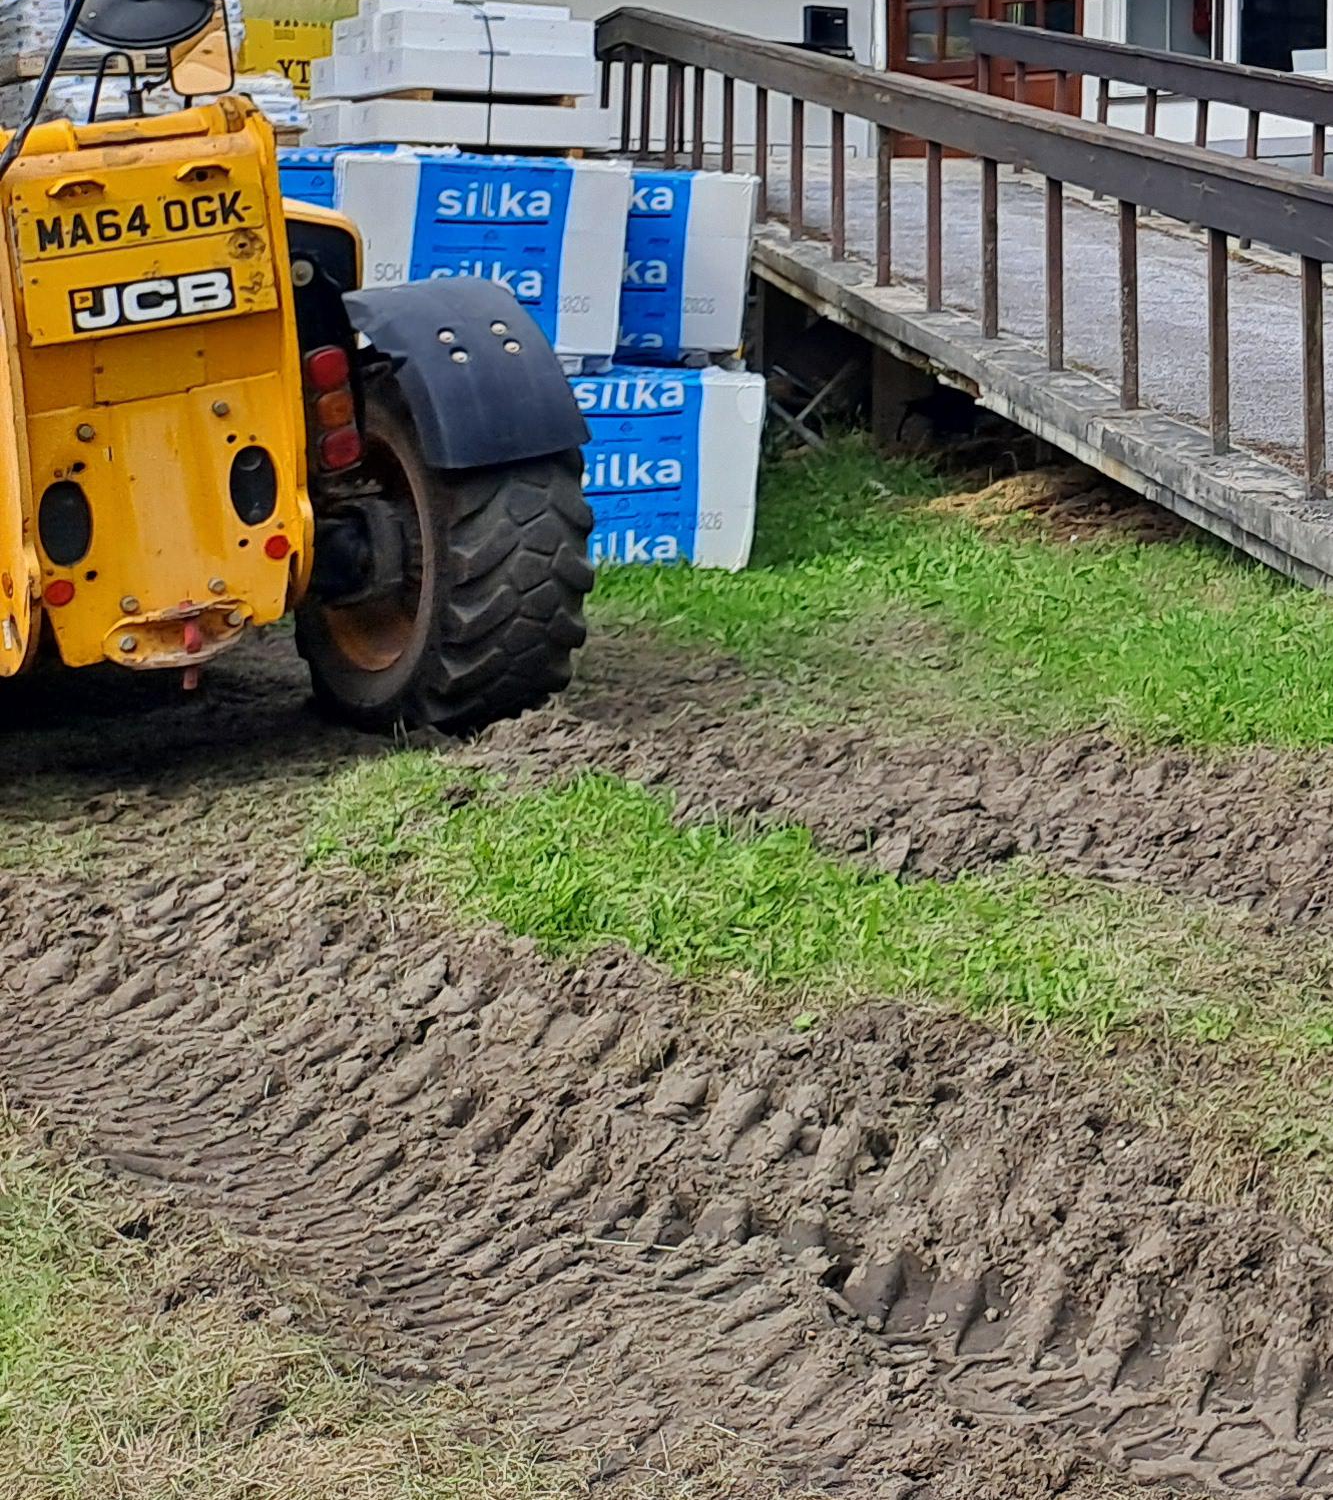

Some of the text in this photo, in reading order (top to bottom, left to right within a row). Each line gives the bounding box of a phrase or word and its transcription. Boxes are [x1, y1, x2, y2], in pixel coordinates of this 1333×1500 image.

[36, 190, 246, 252] MA64 OGK
[436, 182, 552, 217] silka
[74, 271, 233, 329] JCB
[573, 379, 686, 411] silka
